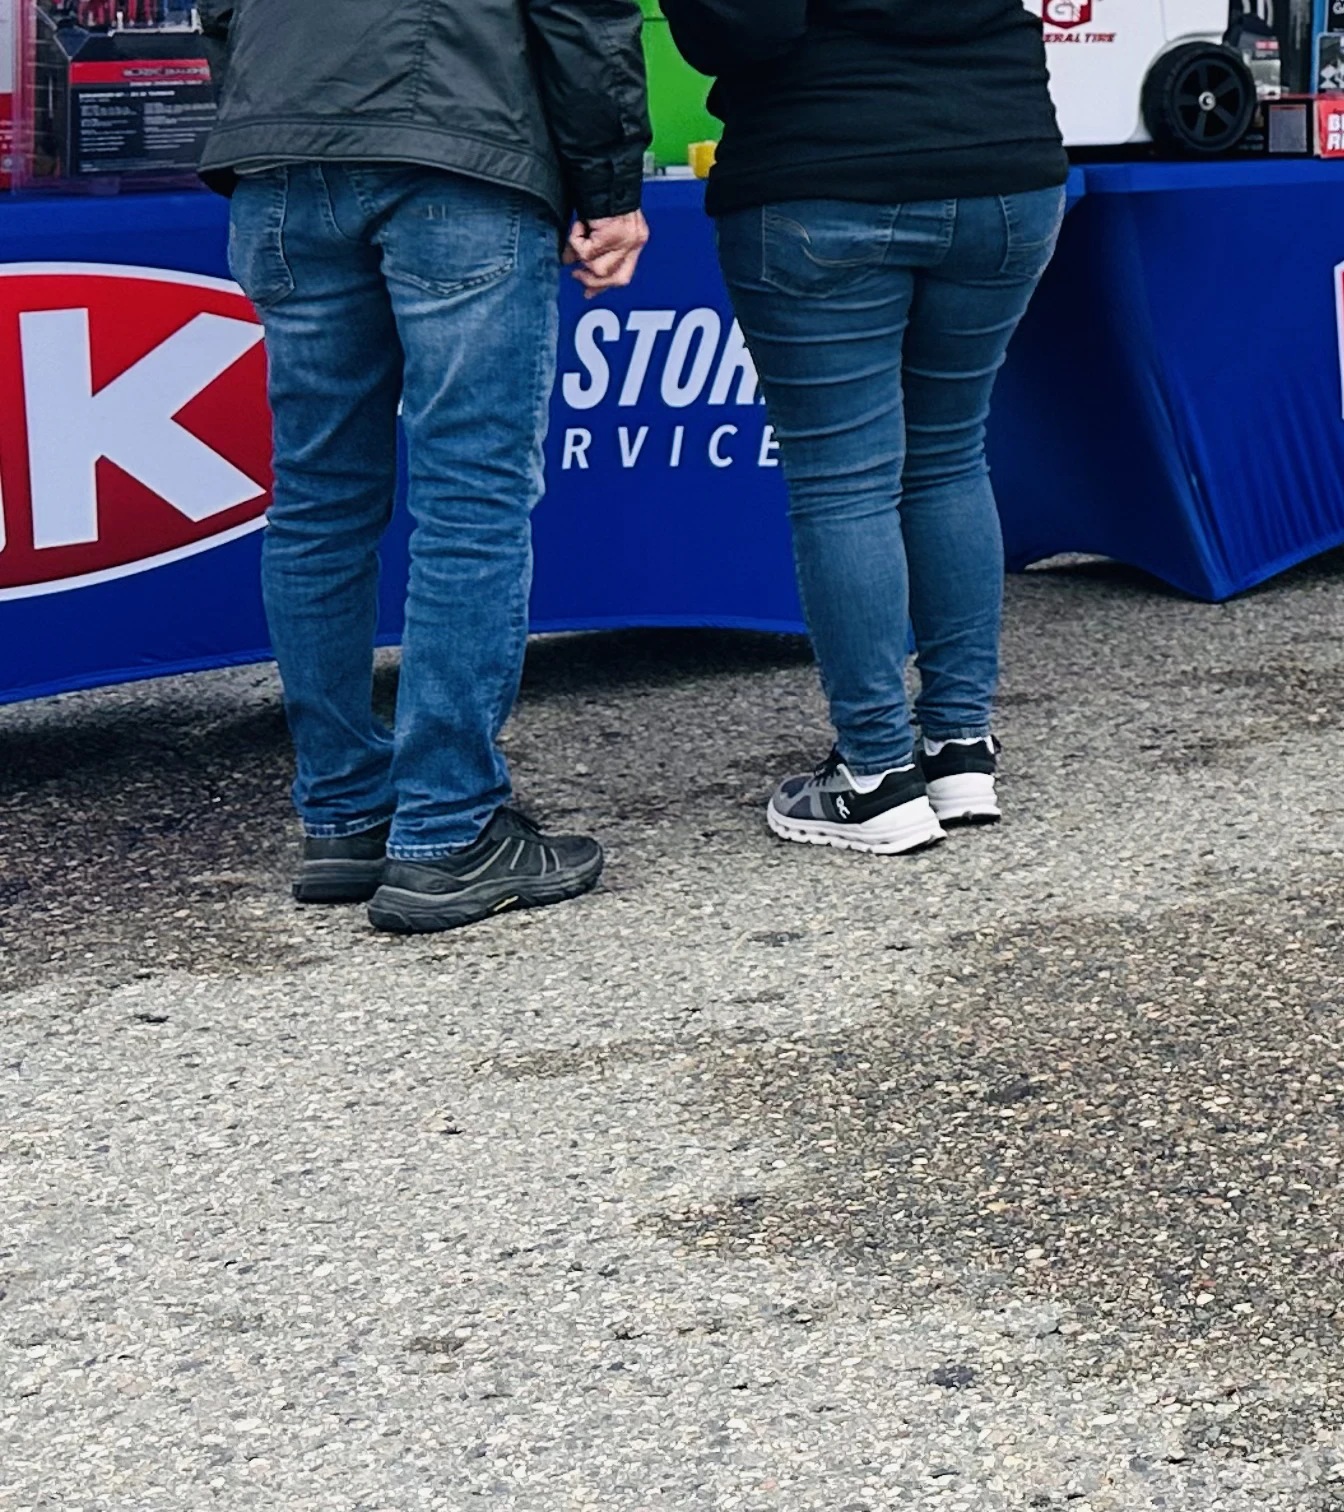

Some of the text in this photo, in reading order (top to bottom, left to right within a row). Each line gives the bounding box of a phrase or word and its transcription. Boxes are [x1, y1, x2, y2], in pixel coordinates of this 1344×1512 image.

[1083, 32, 1117, 44] TIRE
[562, 307, 767, 410] STOR
[0, 307, 267, 551] K
